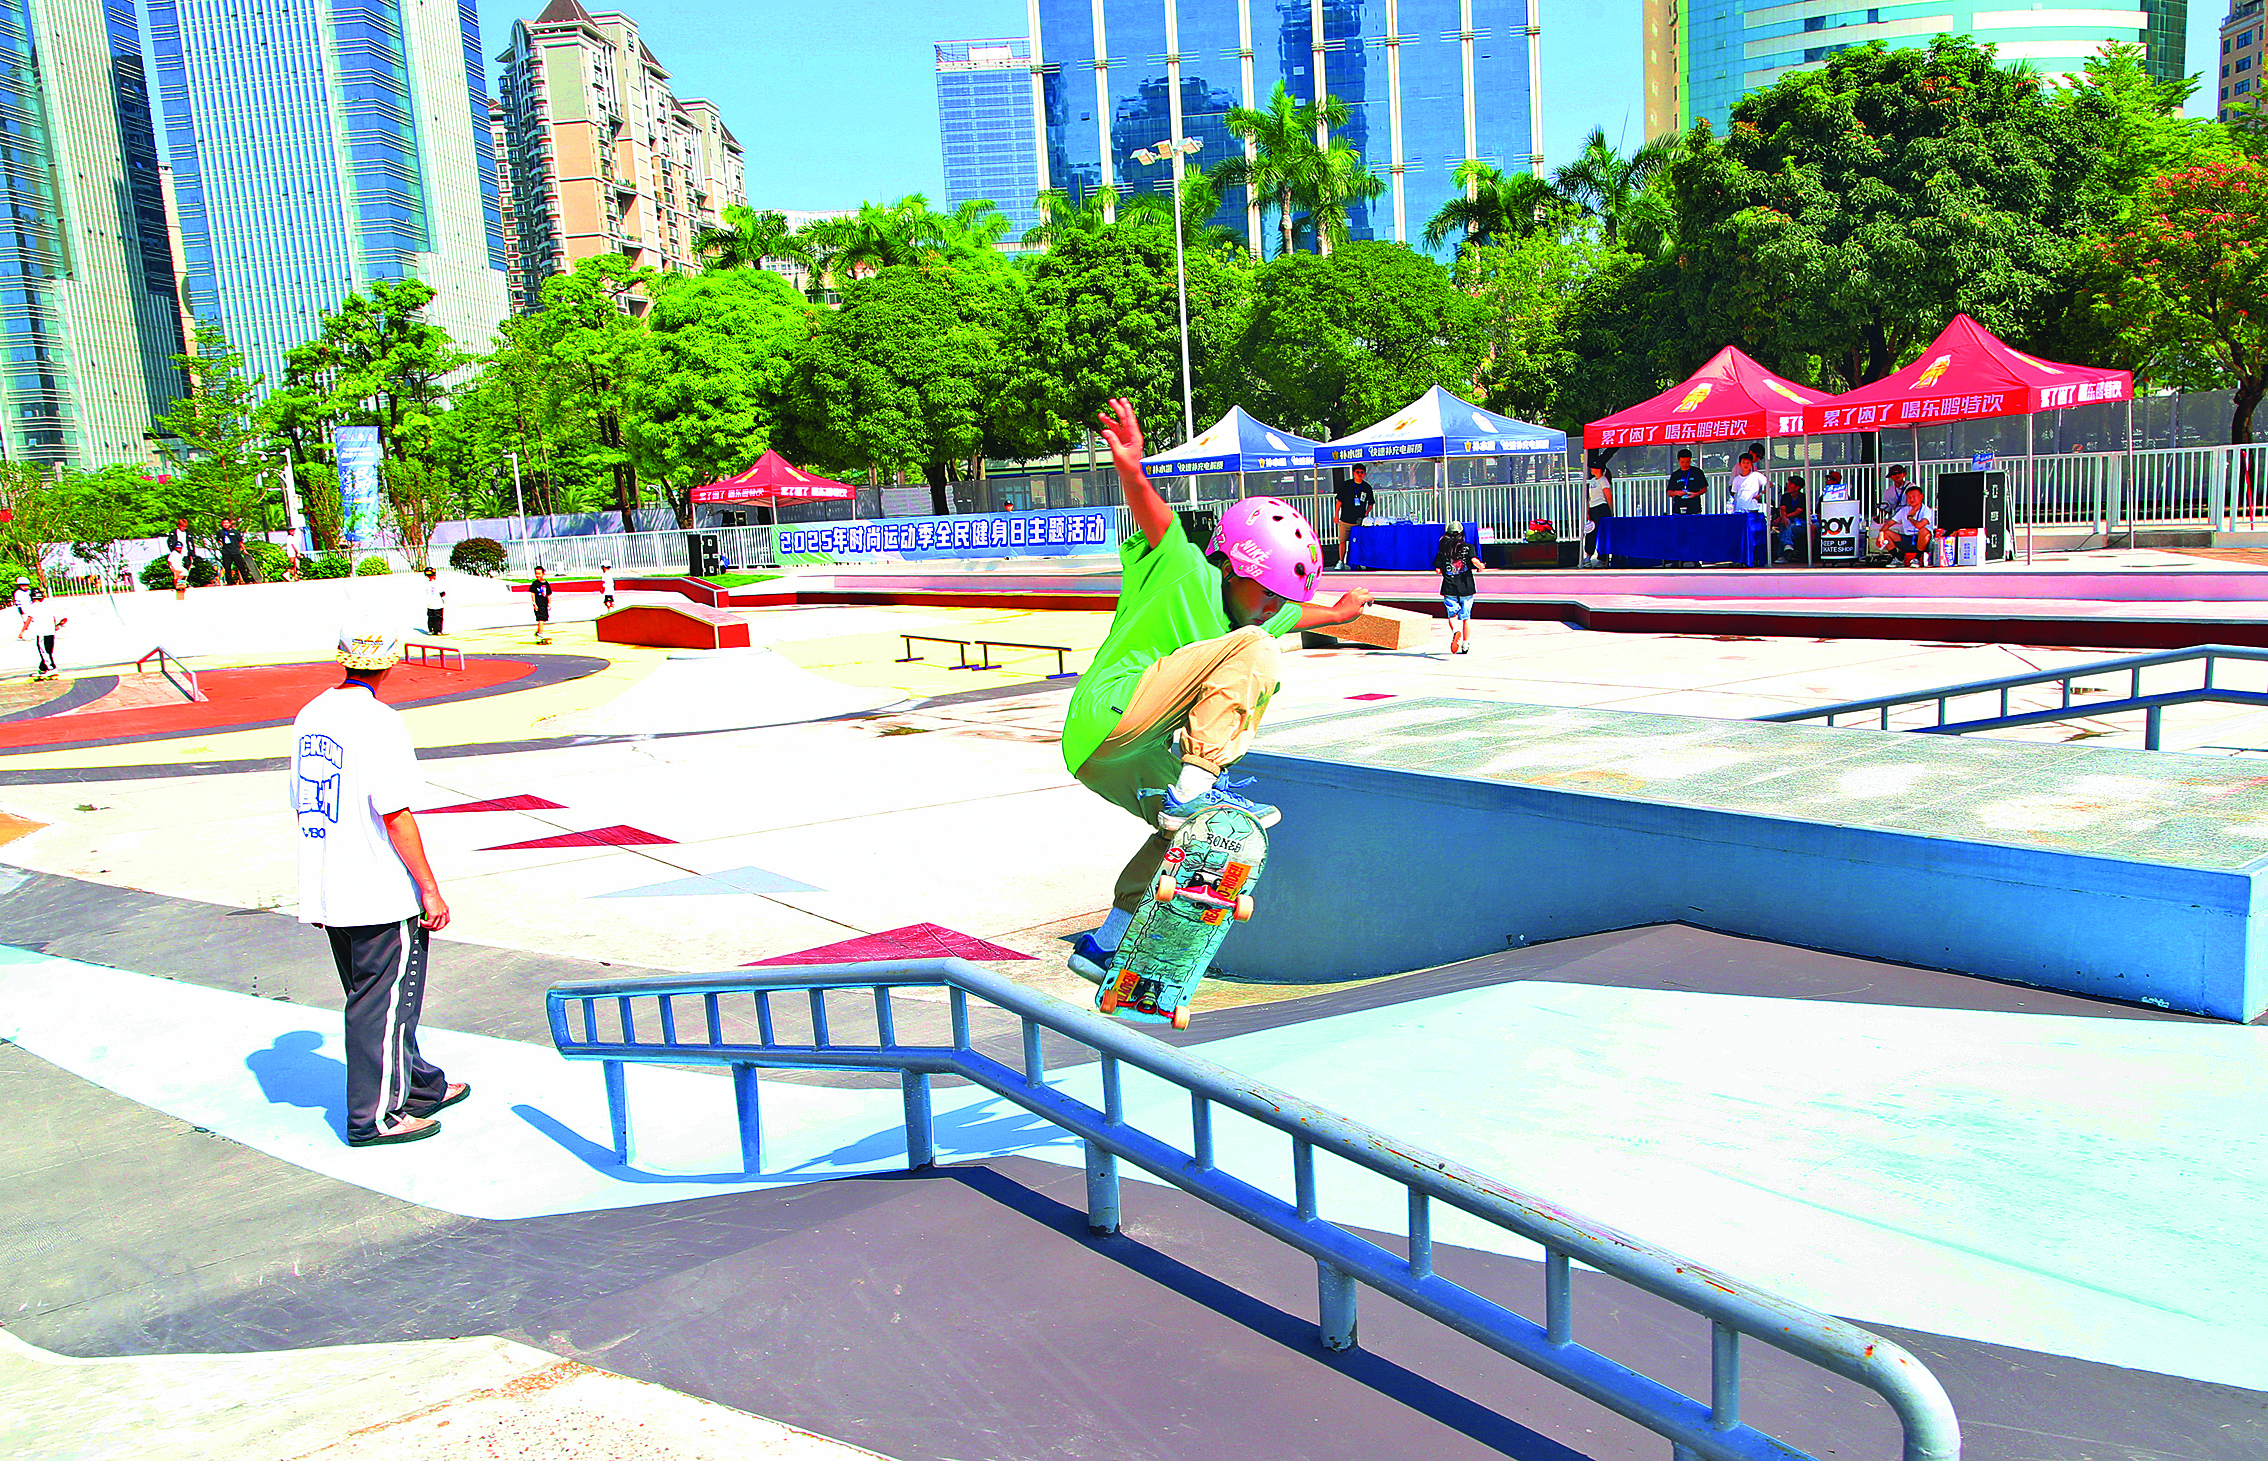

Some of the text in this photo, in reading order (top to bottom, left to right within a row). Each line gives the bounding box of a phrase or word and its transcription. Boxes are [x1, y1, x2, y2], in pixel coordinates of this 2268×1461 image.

[1822, 393, 2004, 428] 累了困了 喝东鹏特饮
[1600, 419, 1748, 446] 累了困了 喝东鹏特饮
[779, 512, 1107, 554] 2025年时尚运动季全民健身日主题活动
[1240, 539, 1269, 562] NIKE
[1206, 832, 1242, 854] BONES
